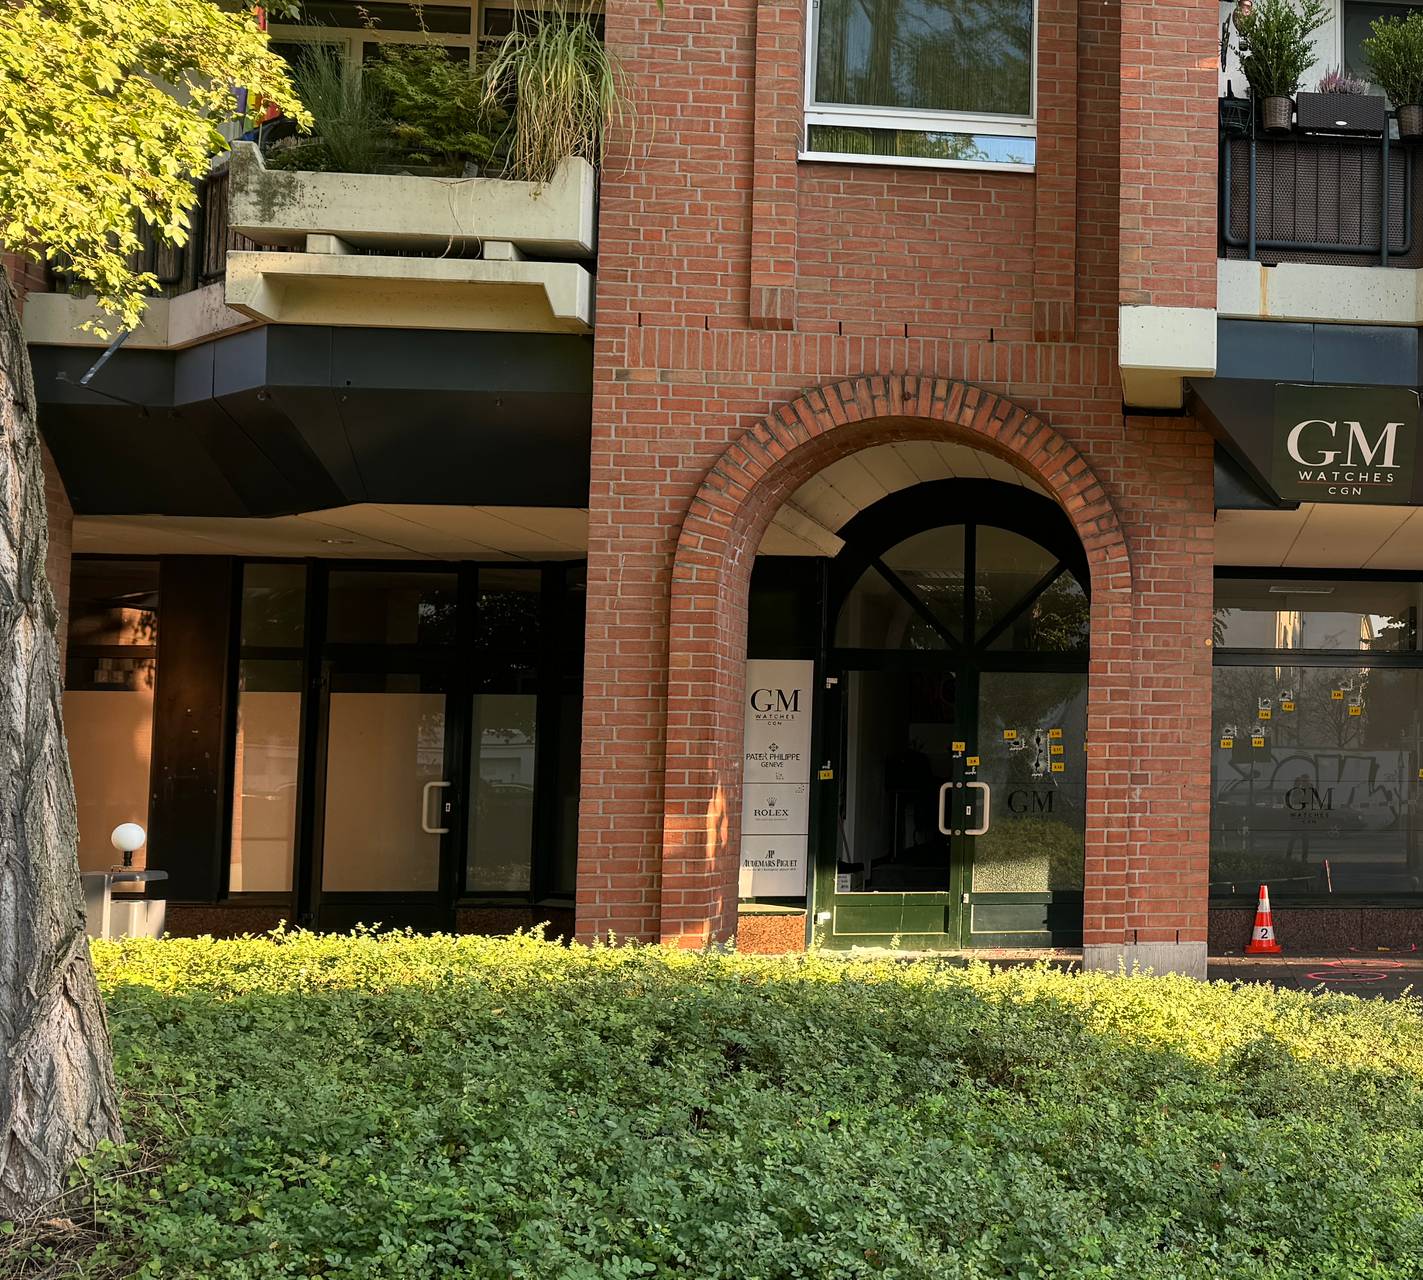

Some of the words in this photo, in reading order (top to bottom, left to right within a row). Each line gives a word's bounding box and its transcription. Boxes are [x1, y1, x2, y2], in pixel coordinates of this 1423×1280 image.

[1287, 420, 1405, 468] GM
[1299, 471, 1394, 482] WATCHES
[1328, 487, 1361, 495] CGN
[750, 688, 802, 713] GM
[1008, 789, 1057, 814] GM
[1285, 786, 1336, 810] GM
[753, 809, 789, 817] ROLEX
[742, 859, 775, 867] AUDEMARS
[1260, 928, 1268, 939] 2
